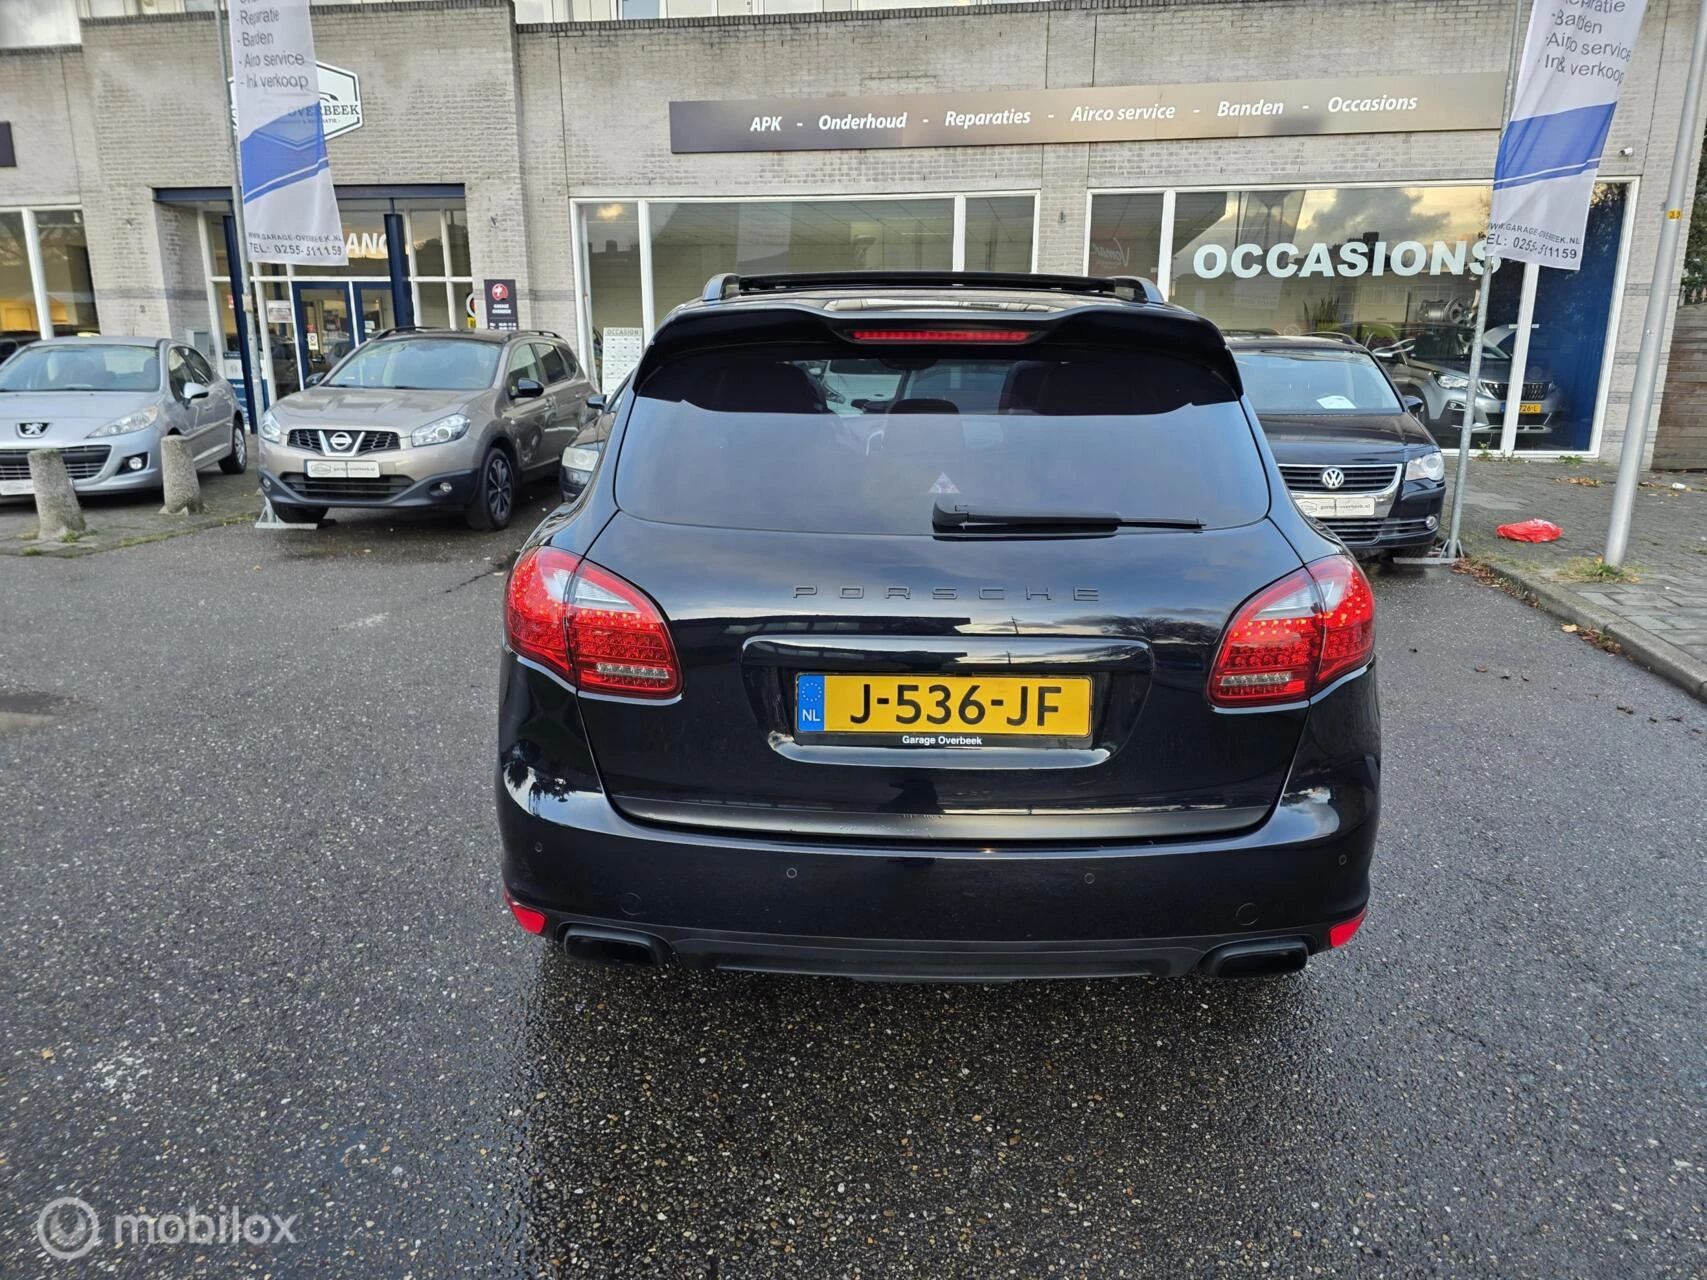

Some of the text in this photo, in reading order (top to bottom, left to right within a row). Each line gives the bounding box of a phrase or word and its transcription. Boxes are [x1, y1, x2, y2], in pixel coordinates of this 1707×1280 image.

[263, 50, 305, 66] service
[261, 73, 309, 90] verkoop
[750, 116, 782, 131] APK
[818, 112, 907, 131] Onderhoud
[945, 108, 1031, 129] Reparaties
[1071, 105, 1114, 122] Airco
[1117, 103, 1176, 121] service
[1217, 100, 1284, 117] Banden
[1328, 95, 1418, 113] Occasions
[249, 242, 342, 257] TEL: 0255-511159
[1193, 241, 1501, 277] OCCASIONS
[793, 584, 1099, 601] PORSCHE
[802, 683, 1062, 727] NL J-536-JF
[902, 735, 983, 746] Garage Overbeek
